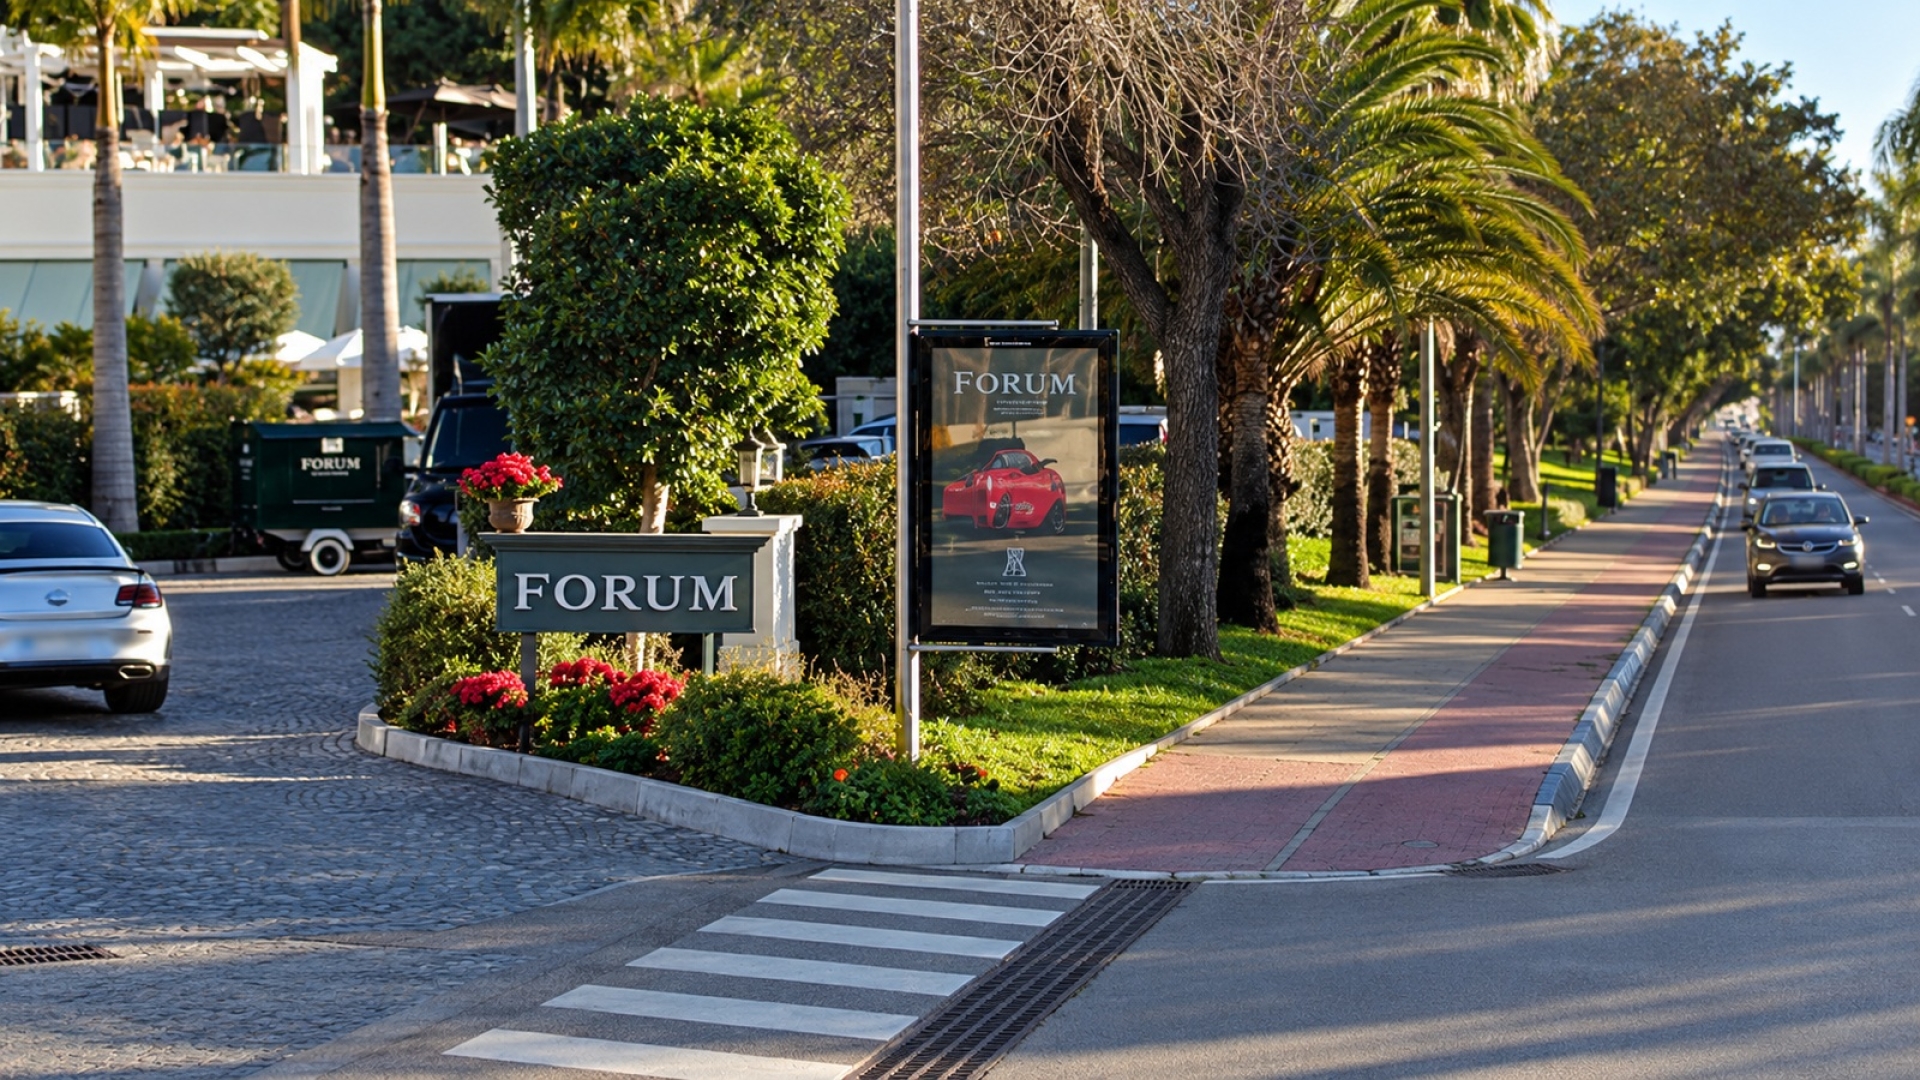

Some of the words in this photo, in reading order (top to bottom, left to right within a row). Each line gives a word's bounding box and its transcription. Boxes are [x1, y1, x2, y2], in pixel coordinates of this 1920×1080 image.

[953, 371, 1077, 395] FORUM
[301, 457, 361, 471] FORUM
[514, 573, 738, 611] FORUM
